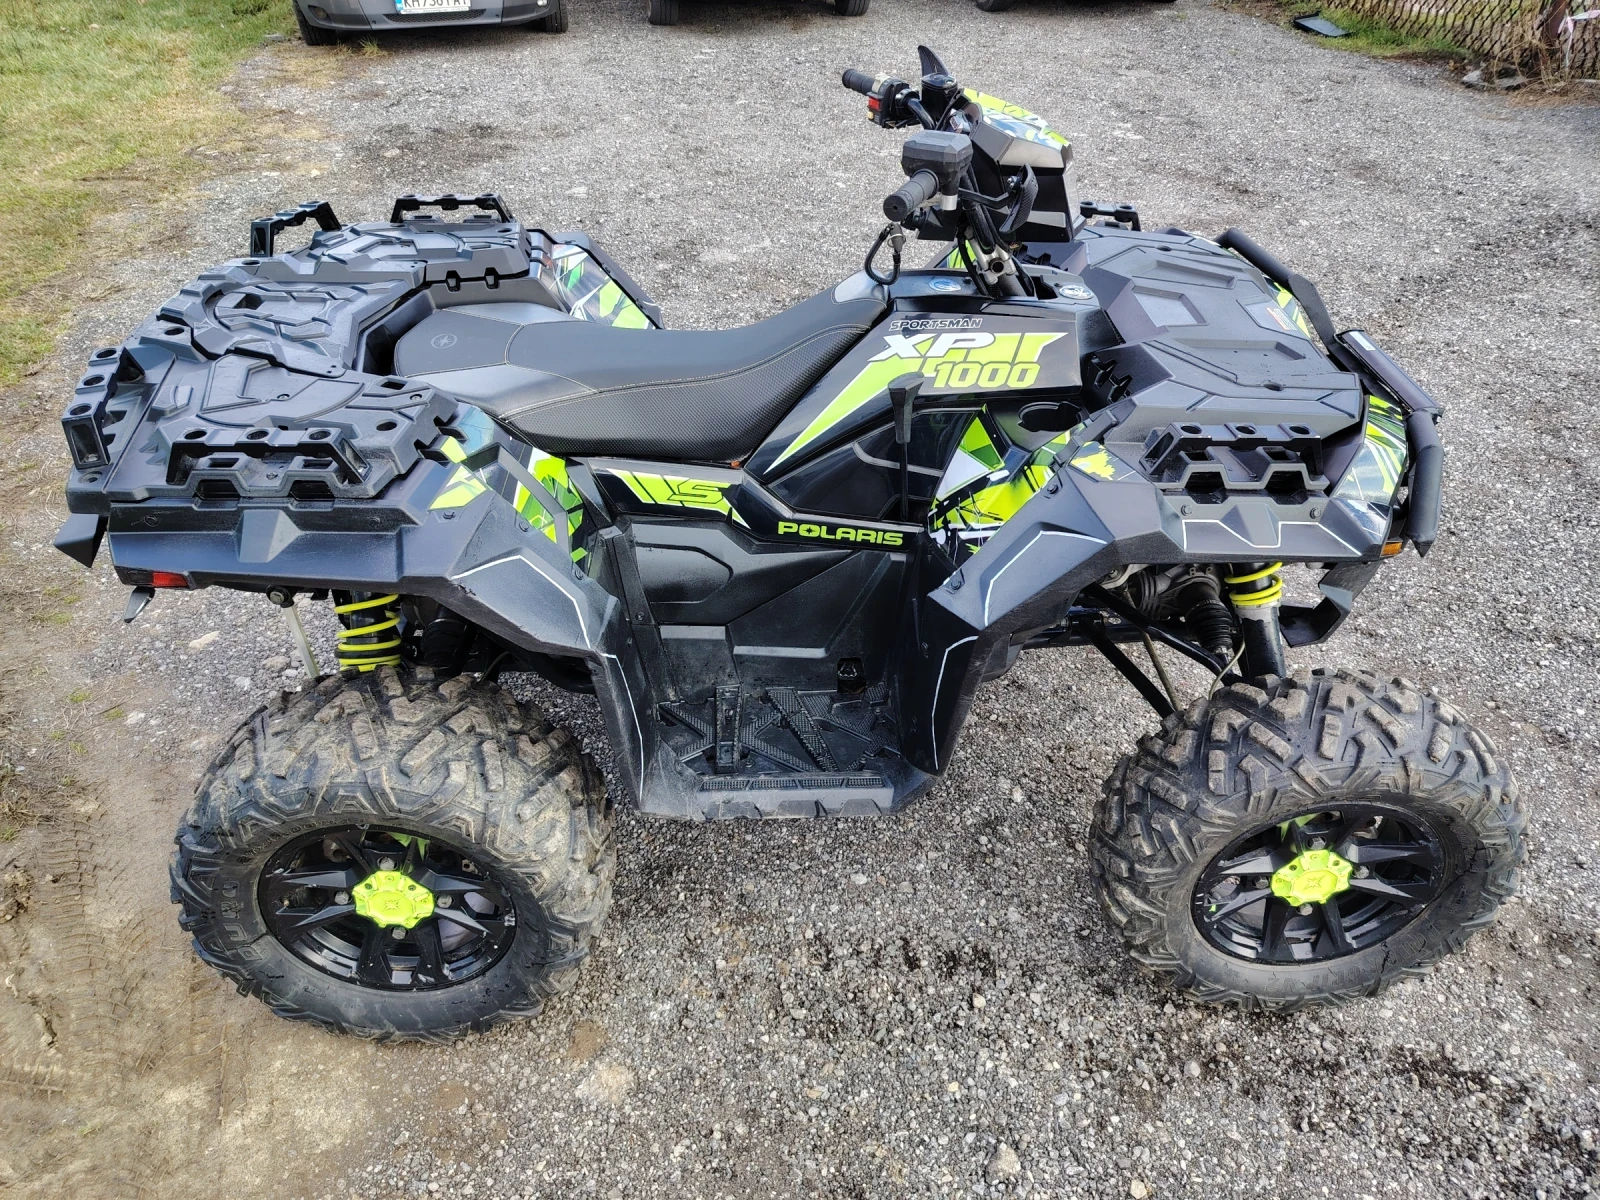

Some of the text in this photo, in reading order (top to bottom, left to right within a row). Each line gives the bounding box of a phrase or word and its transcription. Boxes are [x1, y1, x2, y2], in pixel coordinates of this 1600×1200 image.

[889, 318, 983, 331] SPORTSMAN
[867, 332, 996, 362] XP
[933, 361, 1041, 388] 1000
[777, 520, 904, 546] POLARIS
